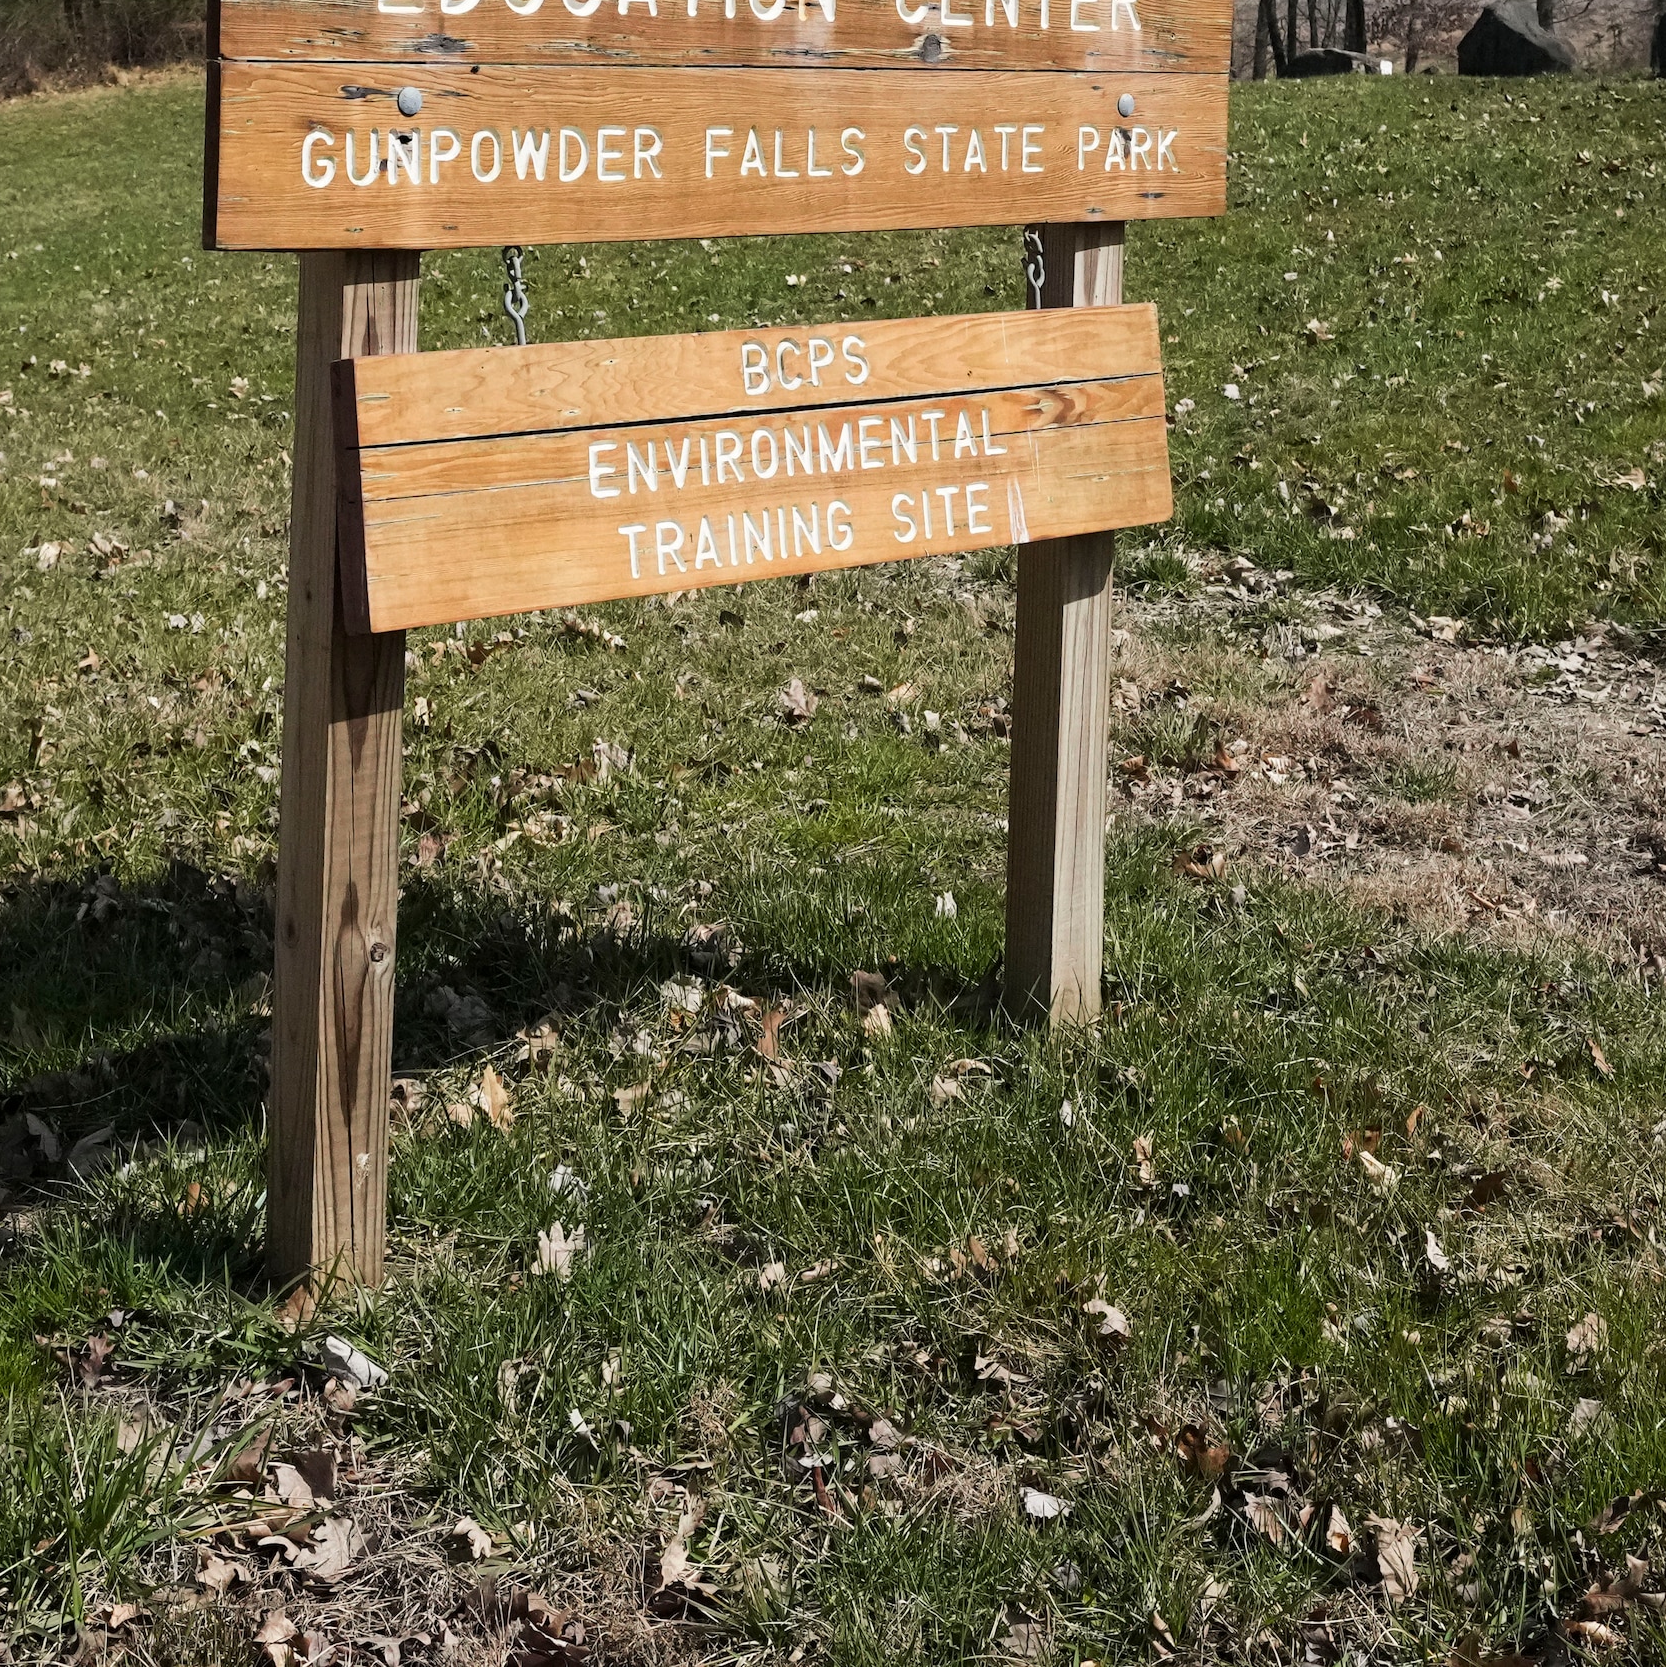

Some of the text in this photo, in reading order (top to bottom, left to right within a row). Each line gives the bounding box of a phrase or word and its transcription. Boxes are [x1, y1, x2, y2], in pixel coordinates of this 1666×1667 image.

[299, 125, 1179, 188] GUNPOWDER FALLS STATE PARK
[741, 335, 870, 397] BCPS
[587, 408, 1008, 500] ENVIRONMENTAL
[618, 482, 994, 580] TRAINING SITE
